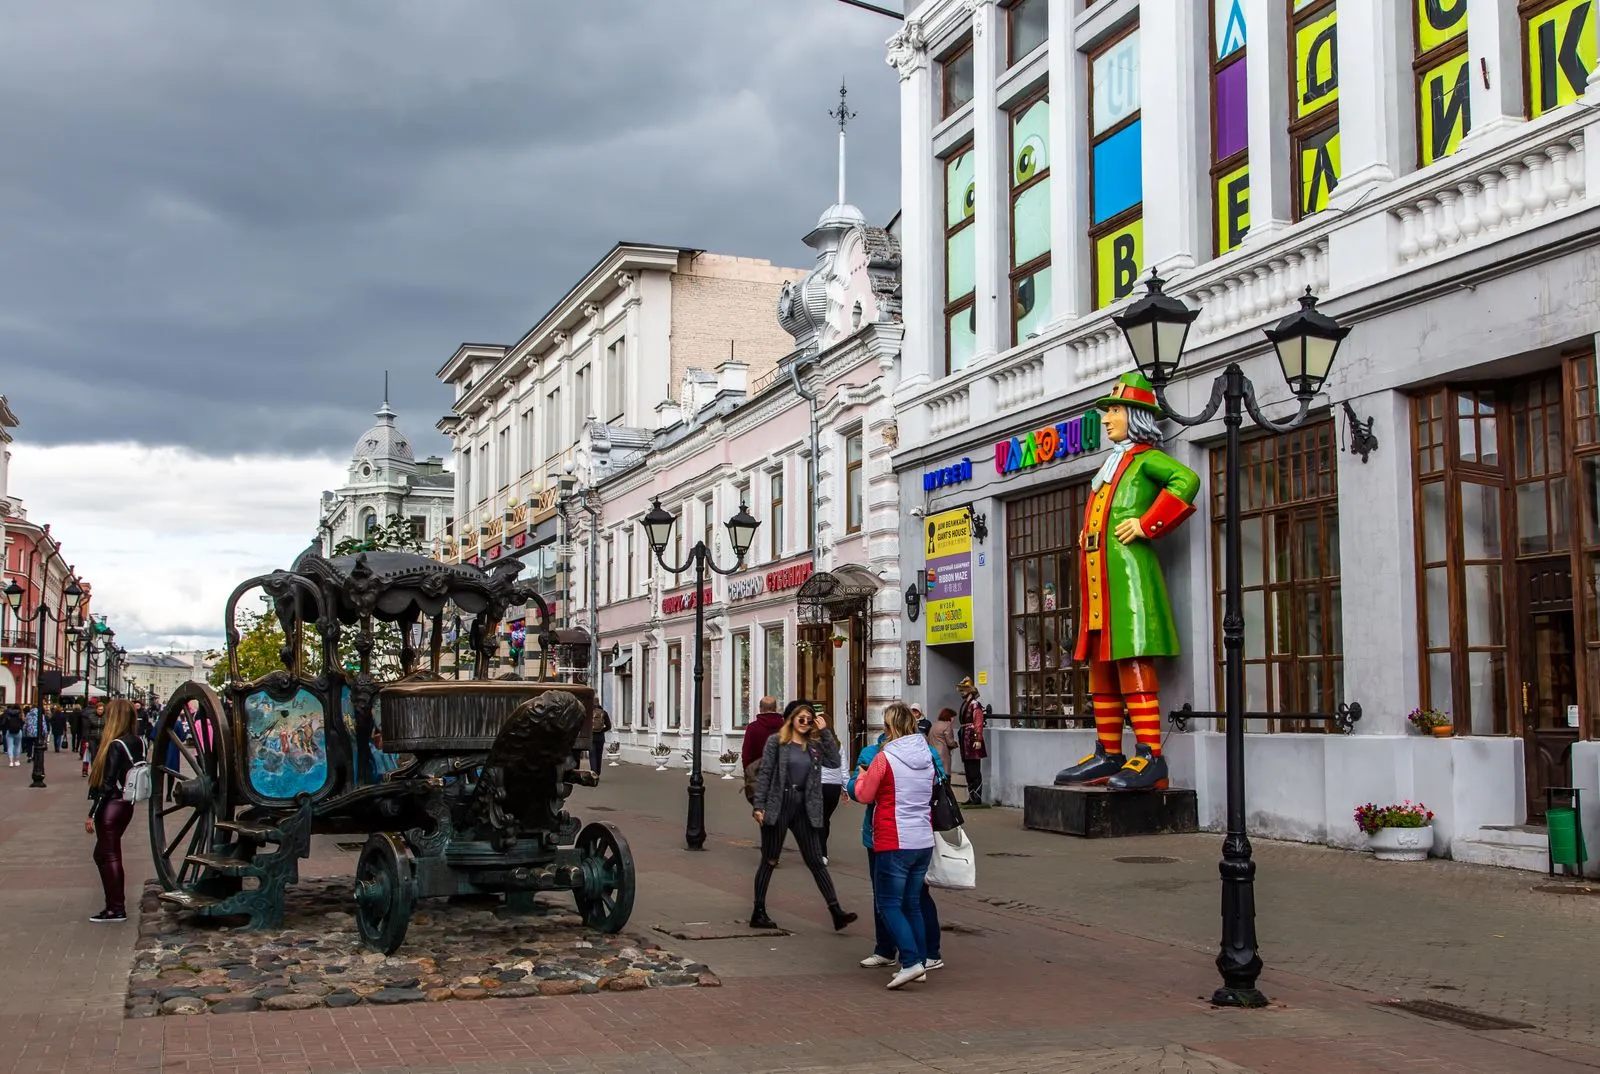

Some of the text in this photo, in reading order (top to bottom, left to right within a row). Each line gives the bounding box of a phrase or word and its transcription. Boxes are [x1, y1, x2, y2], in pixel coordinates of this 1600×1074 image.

[923, 409, 1101, 491] МУЗЕЙ ИЛЛЮЗИЙ
[952, 528, 967, 537] HOUSE
[938, 571, 968, 584] RIBBON MAZE
[728, 575, 764, 601] СЕРЕБРО
[940, 601, 955, 609] МУЗЕЙ
